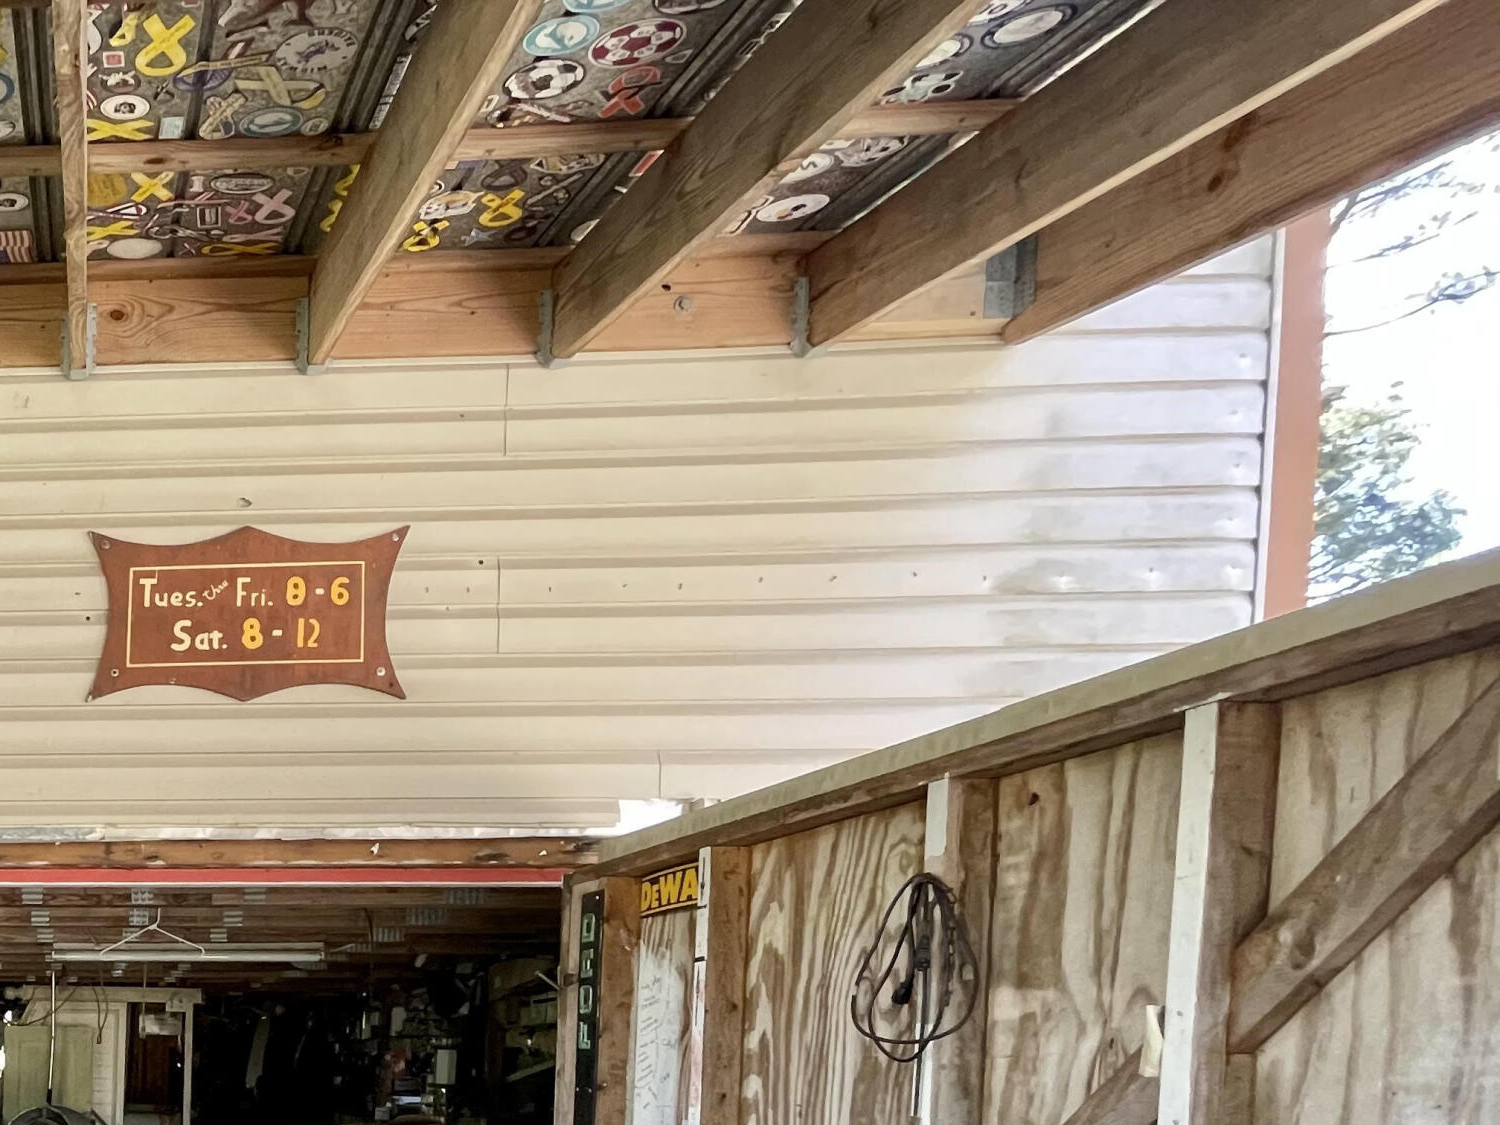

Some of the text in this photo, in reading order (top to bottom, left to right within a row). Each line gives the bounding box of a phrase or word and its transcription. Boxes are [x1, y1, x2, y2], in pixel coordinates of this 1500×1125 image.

[139, 577, 203, 608] Tues.
[202, 579, 229, 601] thru
[236, 576, 274, 608] Fri.
[170, 619, 228, 652] Sat.
[578, 912, 596, 1050] FORD
